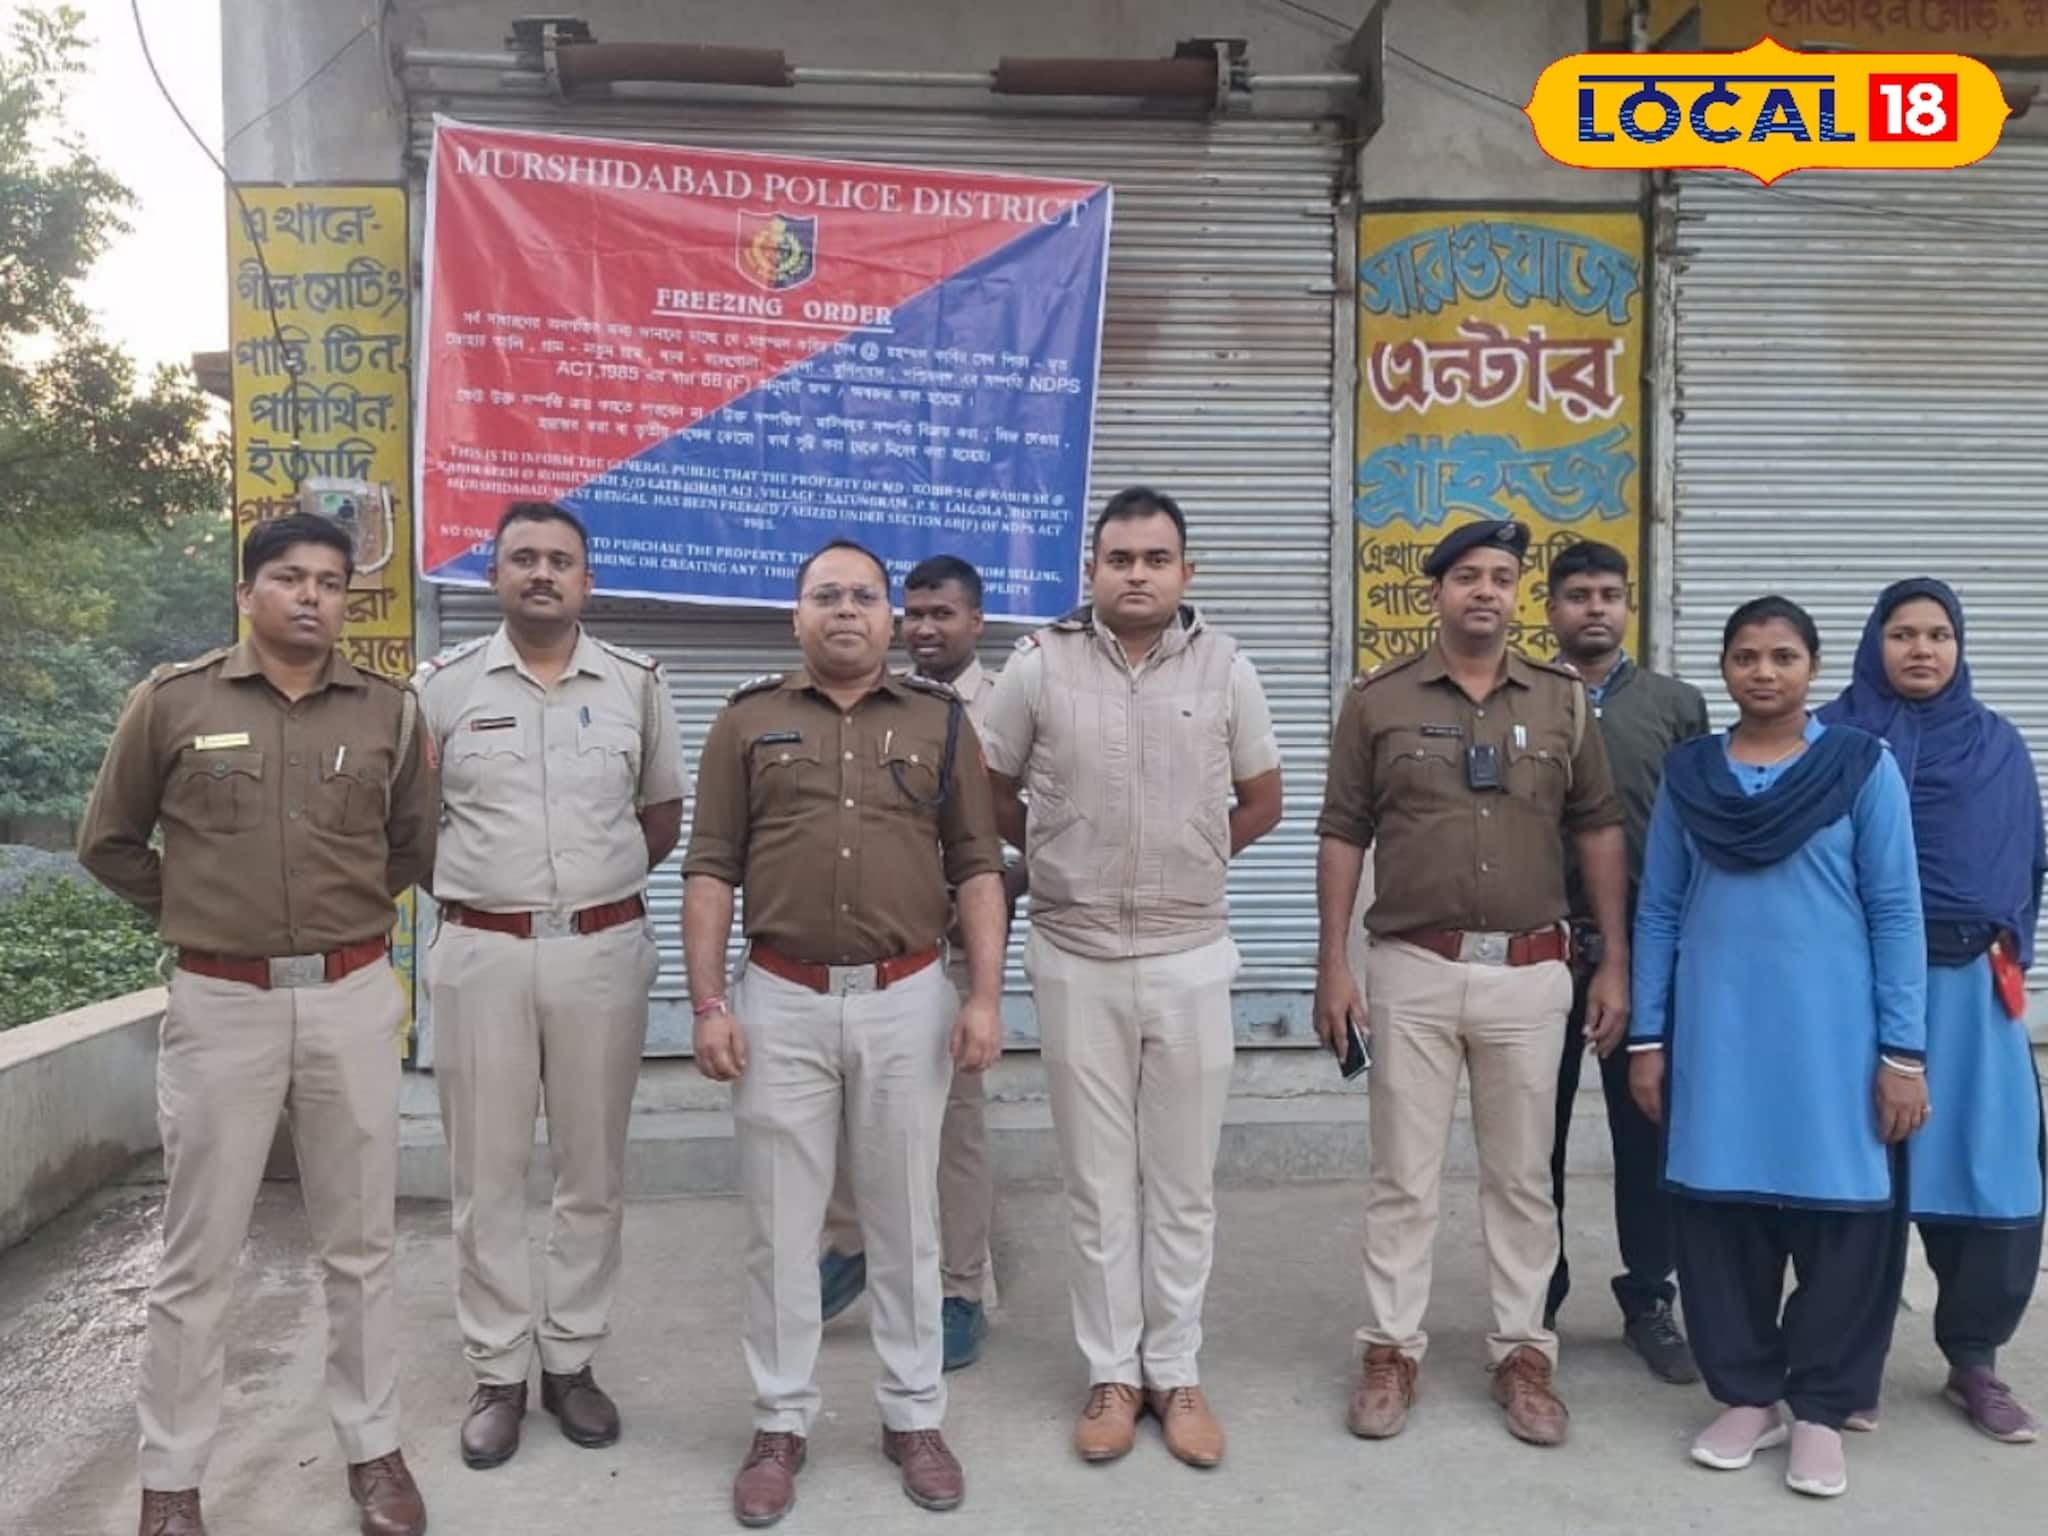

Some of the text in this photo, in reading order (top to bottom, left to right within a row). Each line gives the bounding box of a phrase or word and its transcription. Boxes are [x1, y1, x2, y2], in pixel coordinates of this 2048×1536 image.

[456, 147, 1089, 227] MURSHIDABAD POLICE DISTRICT
[655, 288, 892, 325] FREEZING ORDER
[1030, 376, 1081, 394] NDPS
[521, 450, 576, 467] INFORM
[607, 458, 668, 475] GENERAL
[671, 463, 721, 479] PUBLIC
[723, 467, 760, 482] THAT
[761, 470, 791, 485] THE
[792, 473, 862, 490] PROPERTY
[613, 538, 683, 555] PURCHASE
[688, 543, 711, 557] THE
[716, 546, 785, 563] PROPERTY
